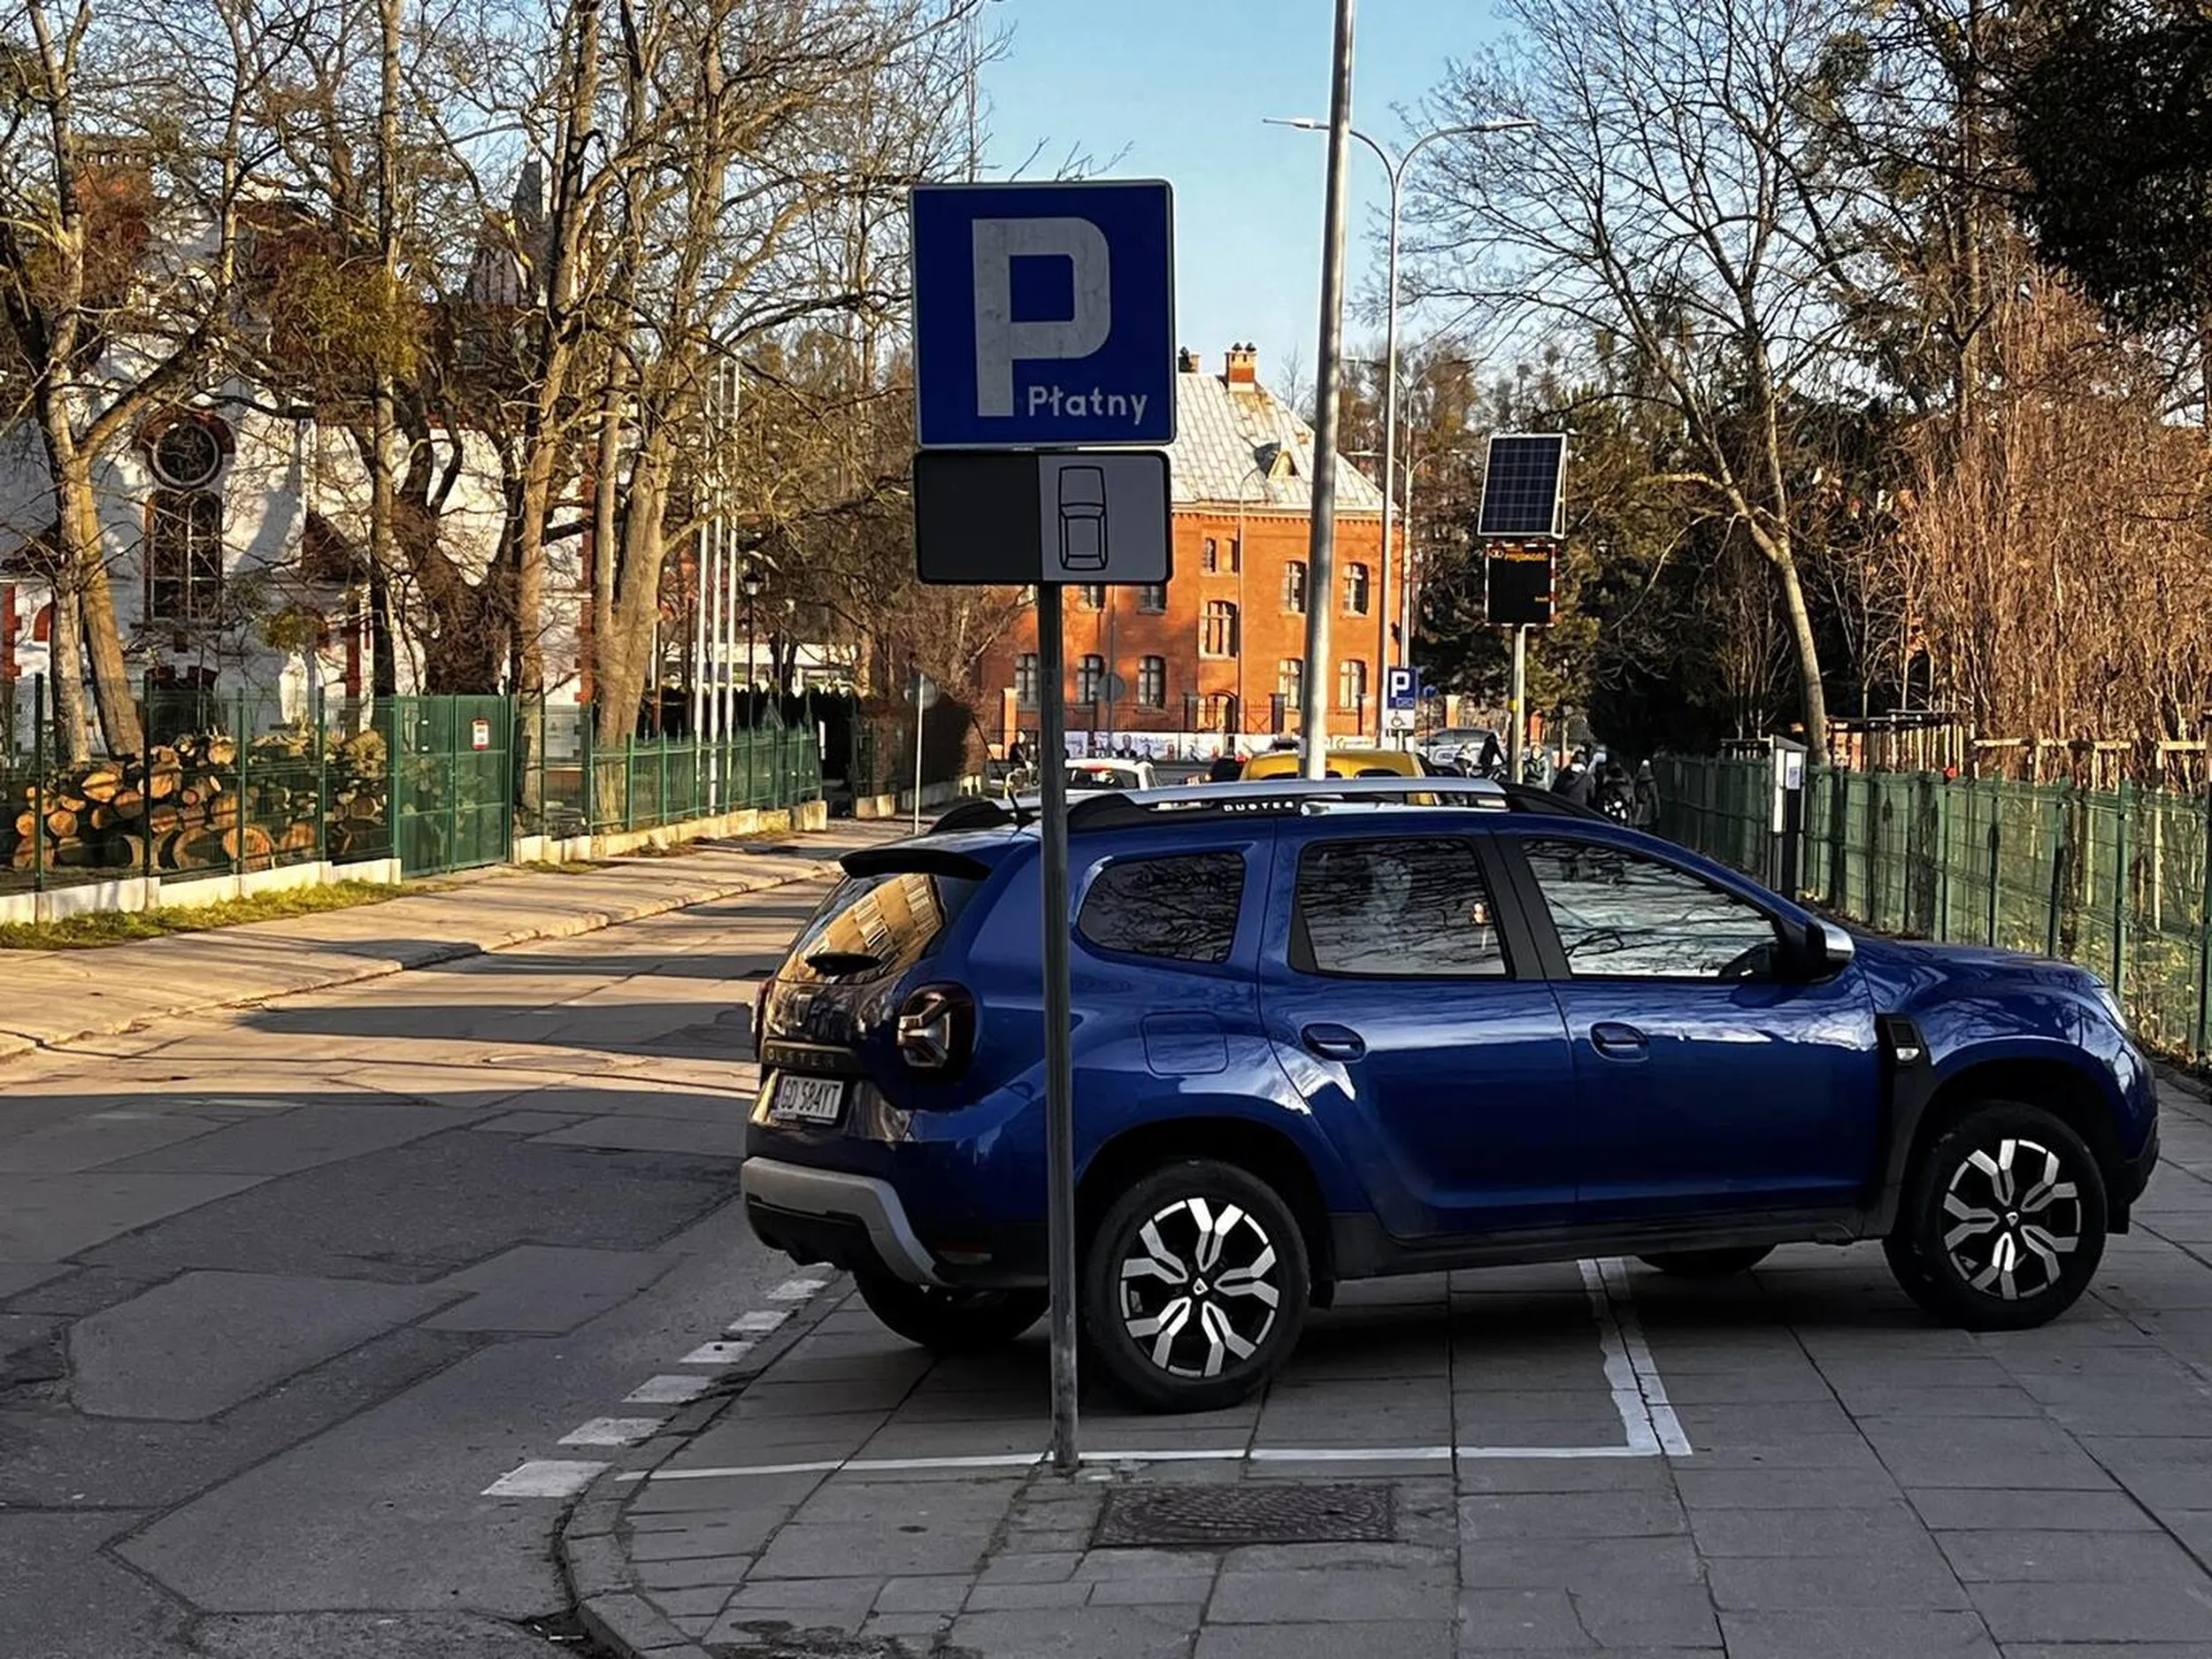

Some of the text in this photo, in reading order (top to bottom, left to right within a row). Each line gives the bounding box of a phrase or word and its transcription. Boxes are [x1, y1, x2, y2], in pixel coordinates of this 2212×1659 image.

[972, 217, 1112, 418] P
[1027, 385, 1148, 426] Płatny
[1391, 671, 1410, 697] P
